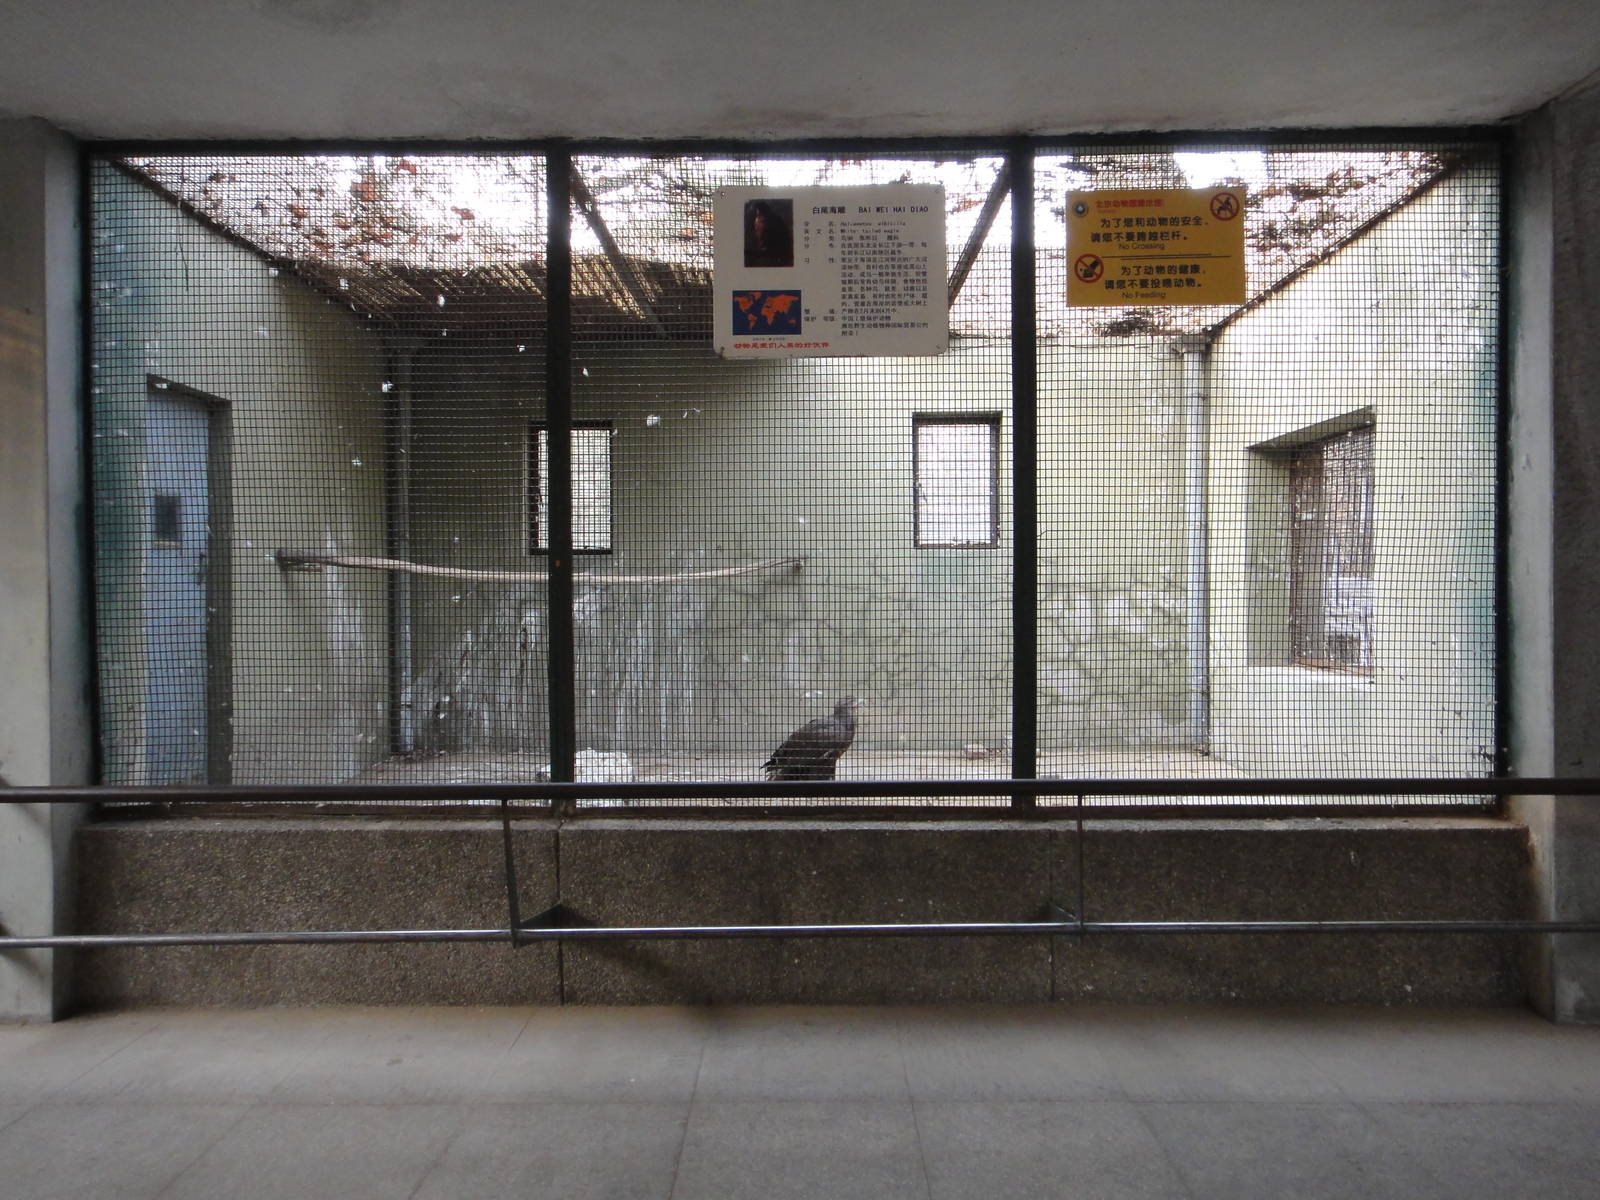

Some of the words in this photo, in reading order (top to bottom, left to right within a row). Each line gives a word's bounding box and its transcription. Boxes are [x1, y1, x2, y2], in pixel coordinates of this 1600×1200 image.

[858, 205, 872, 214] BAI
[875, 205, 889, 214] WEI
[893, 205, 906, 213] HAI
[910, 205, 929, 213] DIAO
[1118, 242, 1130, 250] No
[1131, 242, 1165, 251] Crossing
[1122, 291, 1134, 299] No
[1135, 290, 1167, 300] Feeding
